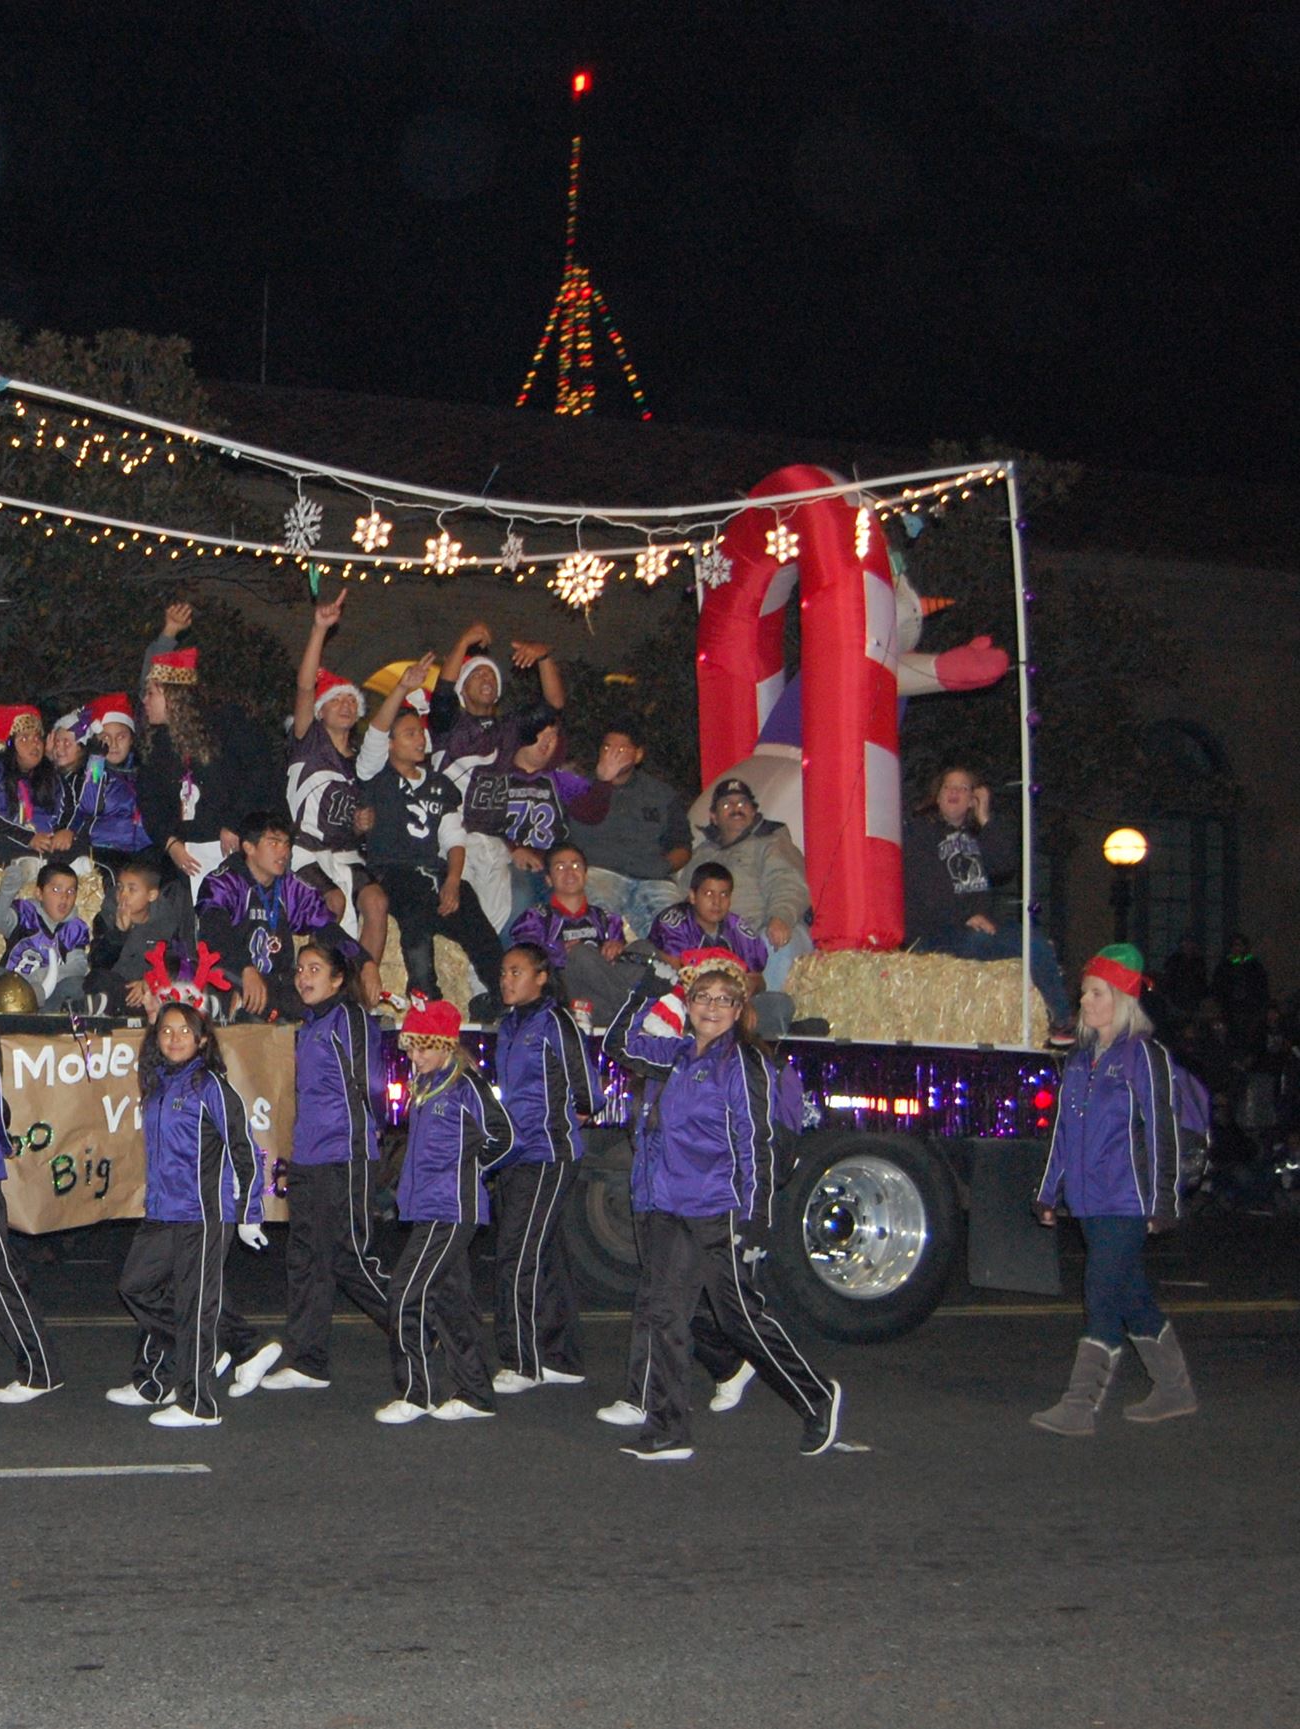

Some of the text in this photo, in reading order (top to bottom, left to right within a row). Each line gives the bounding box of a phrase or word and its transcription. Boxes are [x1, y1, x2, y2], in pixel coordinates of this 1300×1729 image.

[505, 799, 556, 850] 73
[12, 1036, 139, 1089] Mode
[50, 1148, 112, 1200] Big
